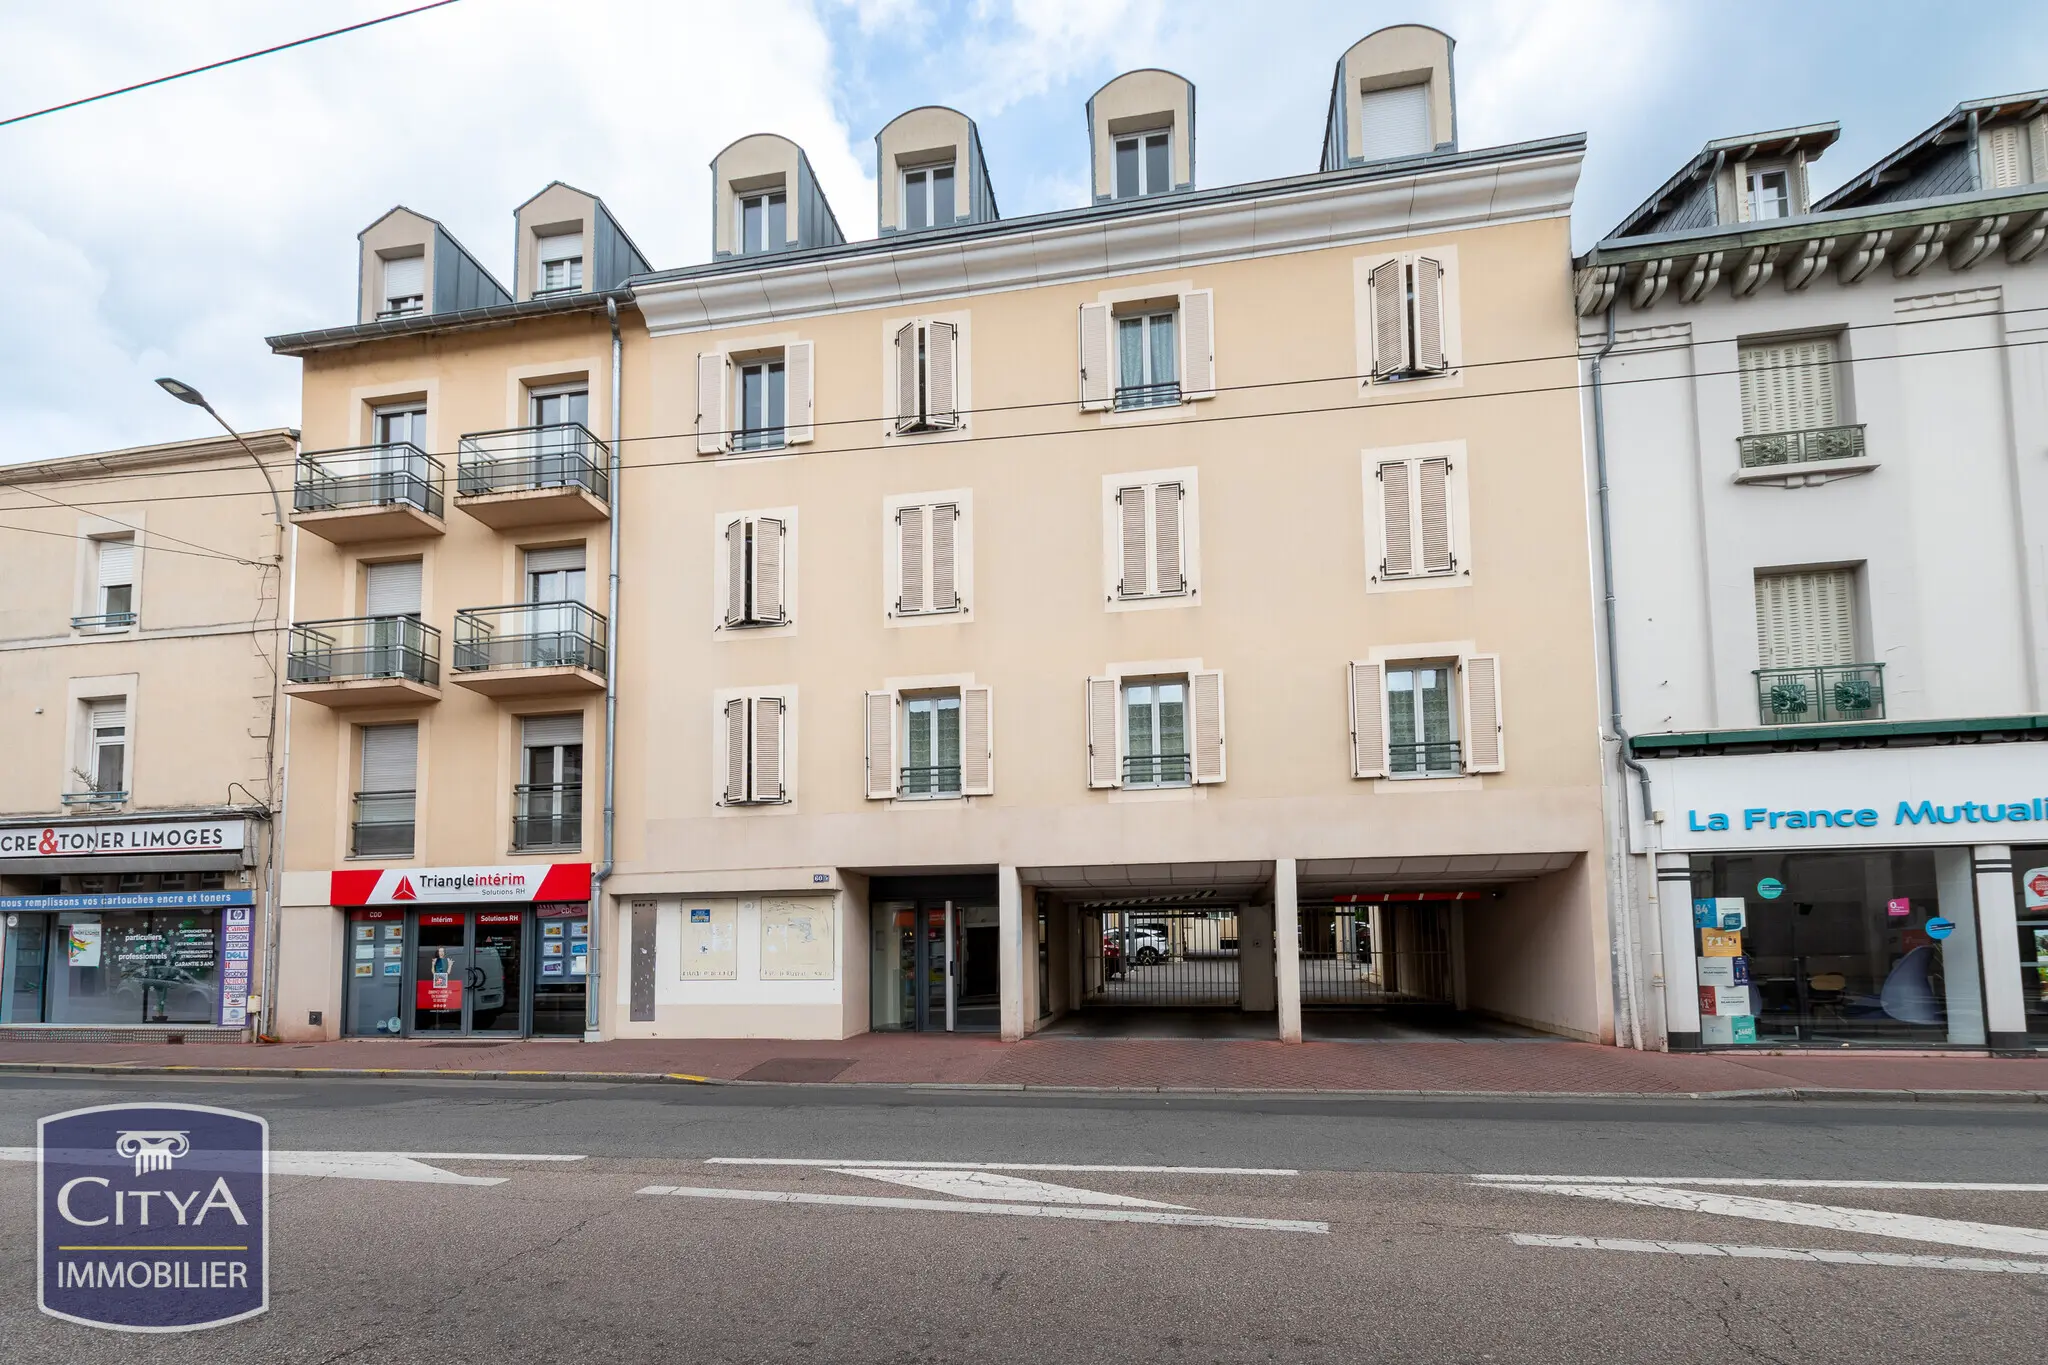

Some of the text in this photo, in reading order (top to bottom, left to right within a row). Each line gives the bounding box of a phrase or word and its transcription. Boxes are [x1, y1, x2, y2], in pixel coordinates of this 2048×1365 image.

[1689, 809, 1729, 832] La
[1744, 808, 1879, 830] France
[131, 828, 223, 847] LIMOGES
[1, 893, 231, 909] nous remplissons vos cartouches encre et toners
[125, 933, 163, 942] particuliers
[118, 952, 168, 961] professionnels
[226, 951, 248, 959] DELL
